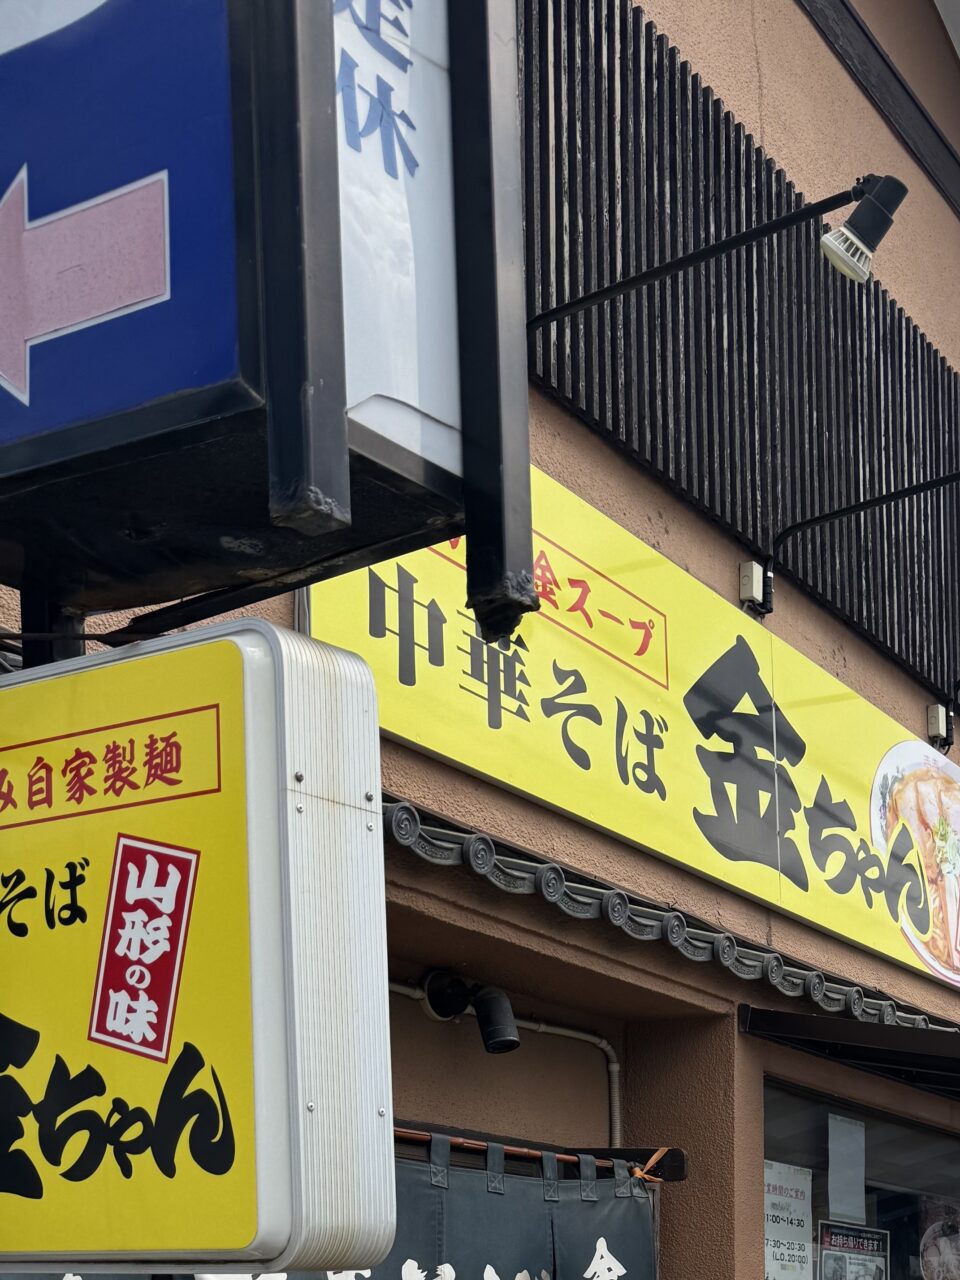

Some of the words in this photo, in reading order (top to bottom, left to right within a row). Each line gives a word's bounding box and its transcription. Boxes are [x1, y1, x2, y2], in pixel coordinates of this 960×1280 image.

[368, 562, 669, 802] 中華そば
[683, 634, 931, 936] 金ちゃん
[105, 853, 183, 1045] 山形の味
[764, 1184, 806, 1200] 業時間のご案内
